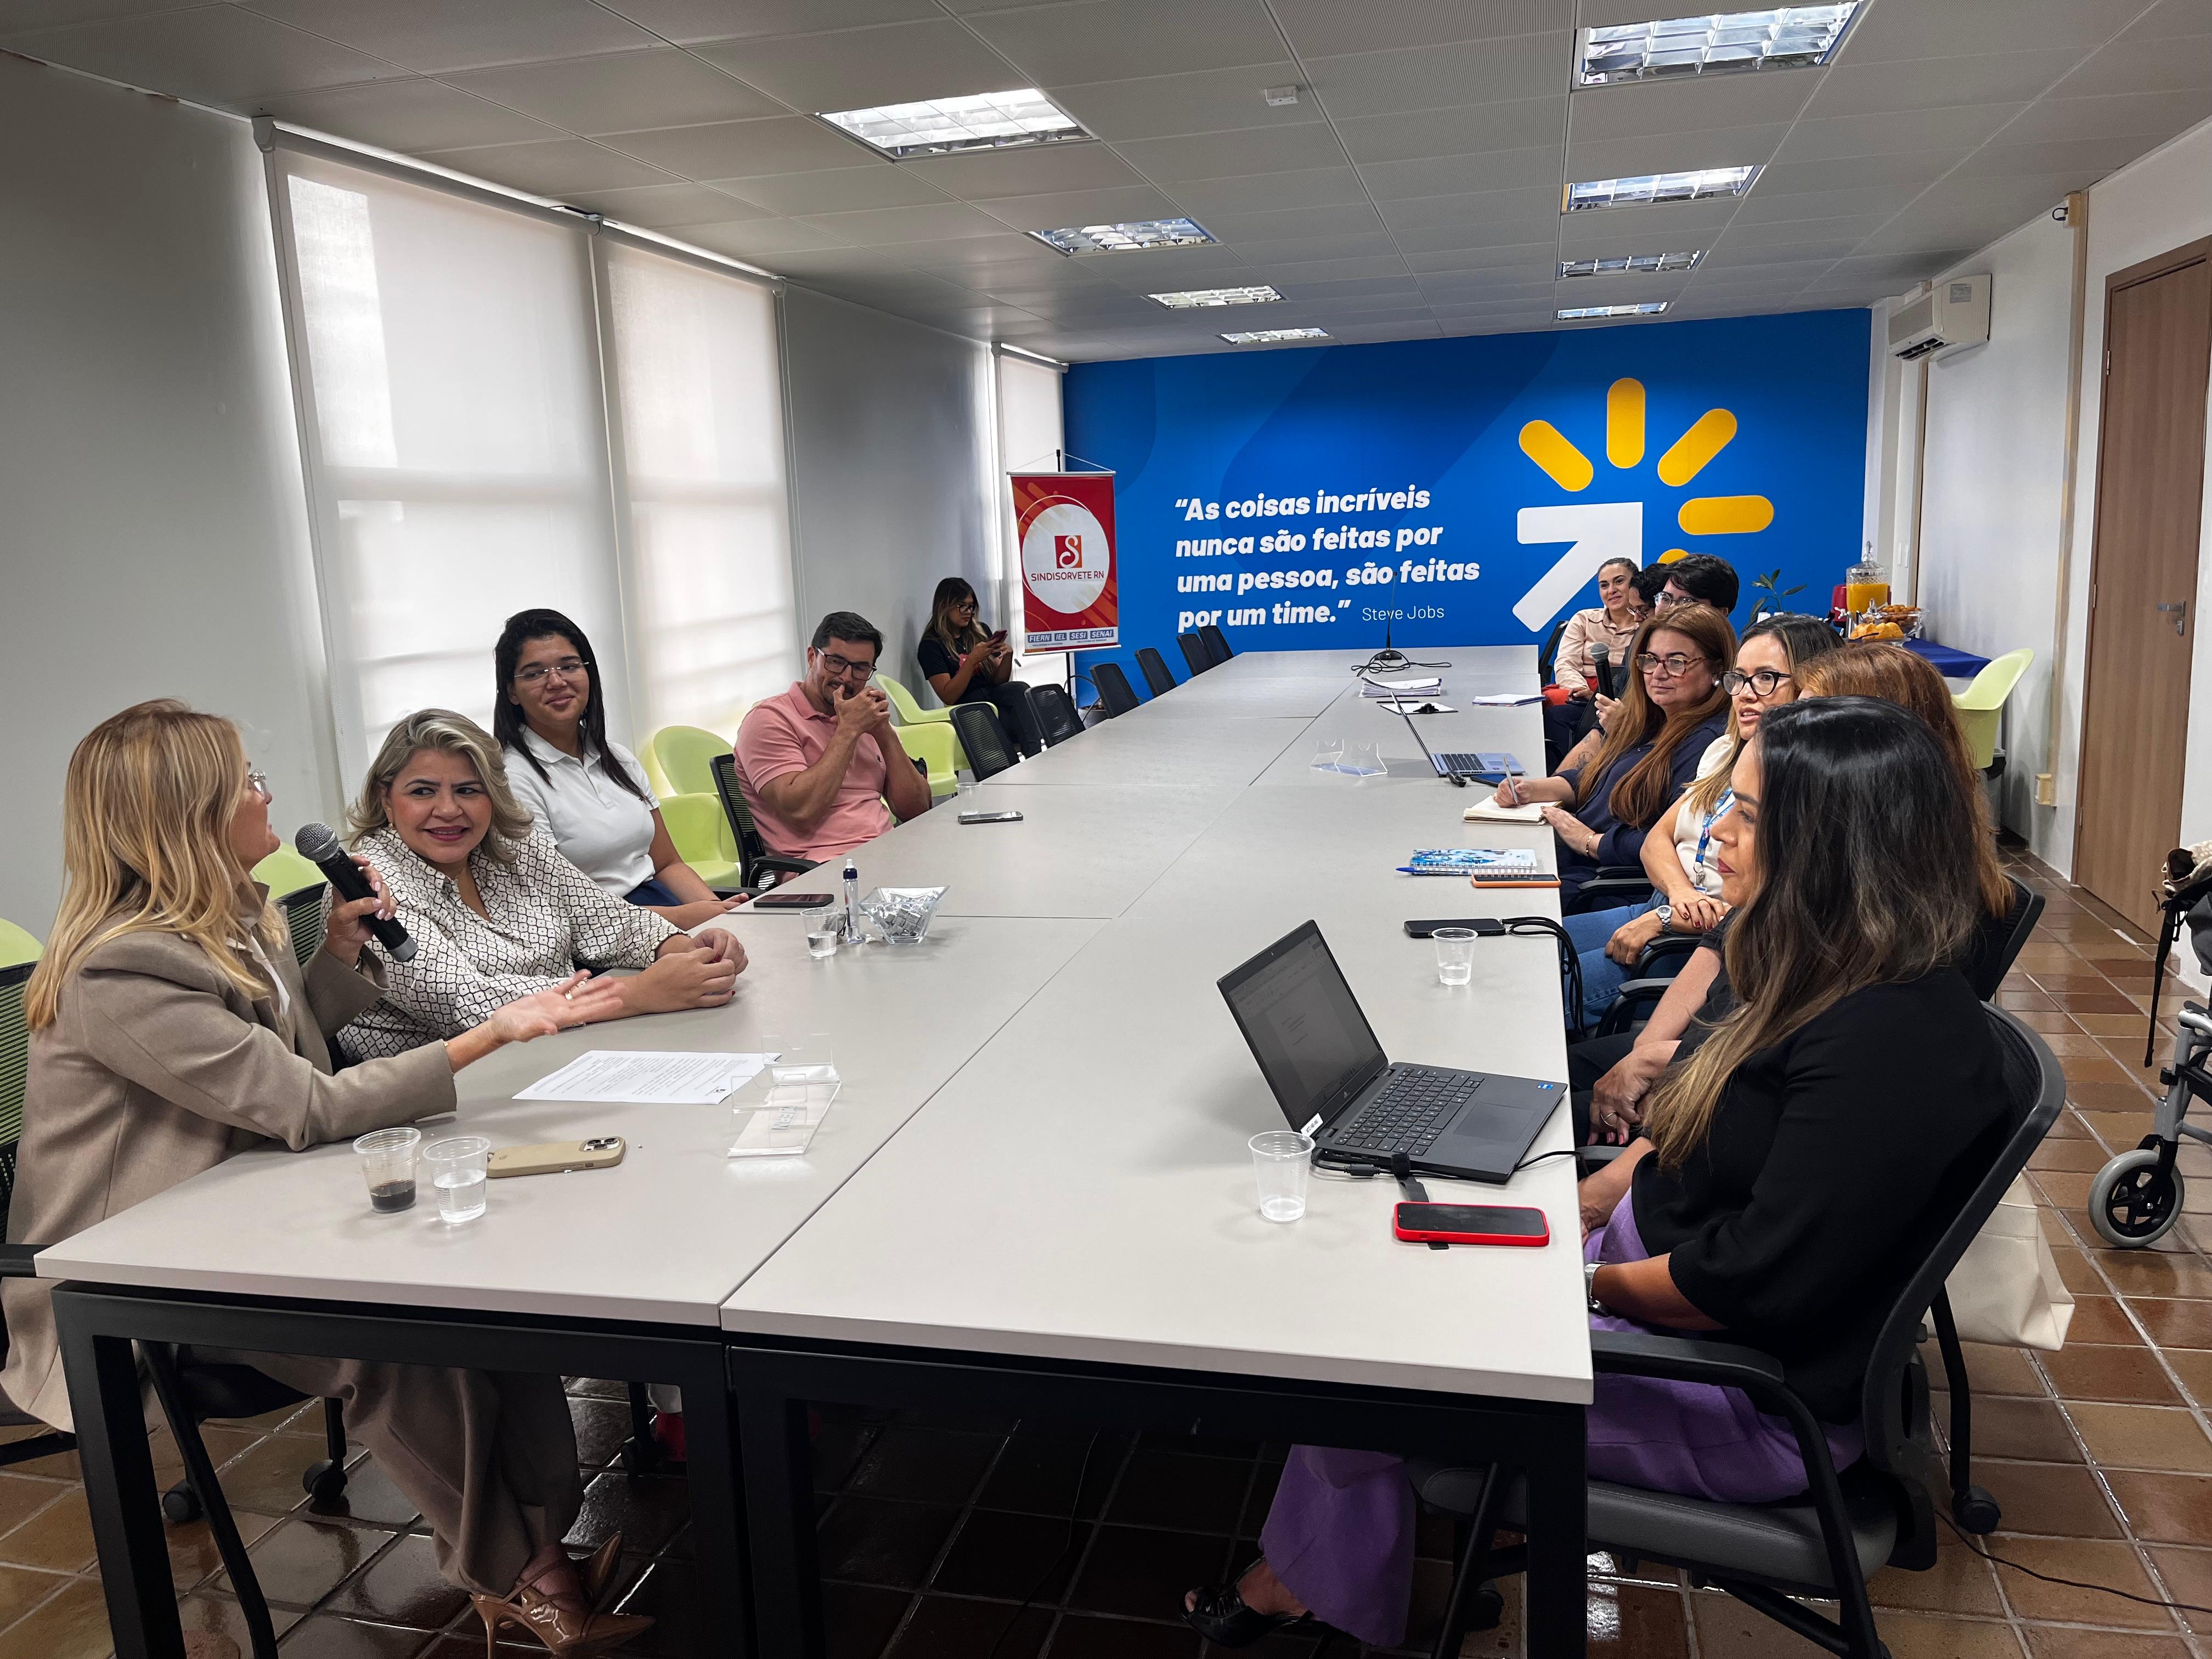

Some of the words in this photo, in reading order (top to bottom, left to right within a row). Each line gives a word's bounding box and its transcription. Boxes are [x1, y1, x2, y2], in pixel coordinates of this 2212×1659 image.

[1225, 493, 1311, 518] coisas
[1316, 484, 1430, 514] incríveis
[1176, 538, 1255, 557] nunca
[1259, 529, 1306, 553] são
[1312, 525, 1391, 550] feitas
[1395, 527, 1443, 552] por
[1031, 571, 1092, 582] SINDISORVETE
[1093, 571, 1104, 579] RN
[1177, 574, 1233, 593] uma
[1237, 569, 1339, 595] pessoa,
[1345, 562, 1393, 585] são
[1400, 557, 1480, 583] feitas
[1178, 610, 1222, 633] por
[1227, 608, 1266, 627] um
[1362, 607, 1403, 621] Steve
[1407, 605, 1444, 619] Jobs
[1029, 634, 1051, 642] FIERN
[1070, 631, 1086, 640] SESI
[1091, 630, 1112, 638] SENAI
